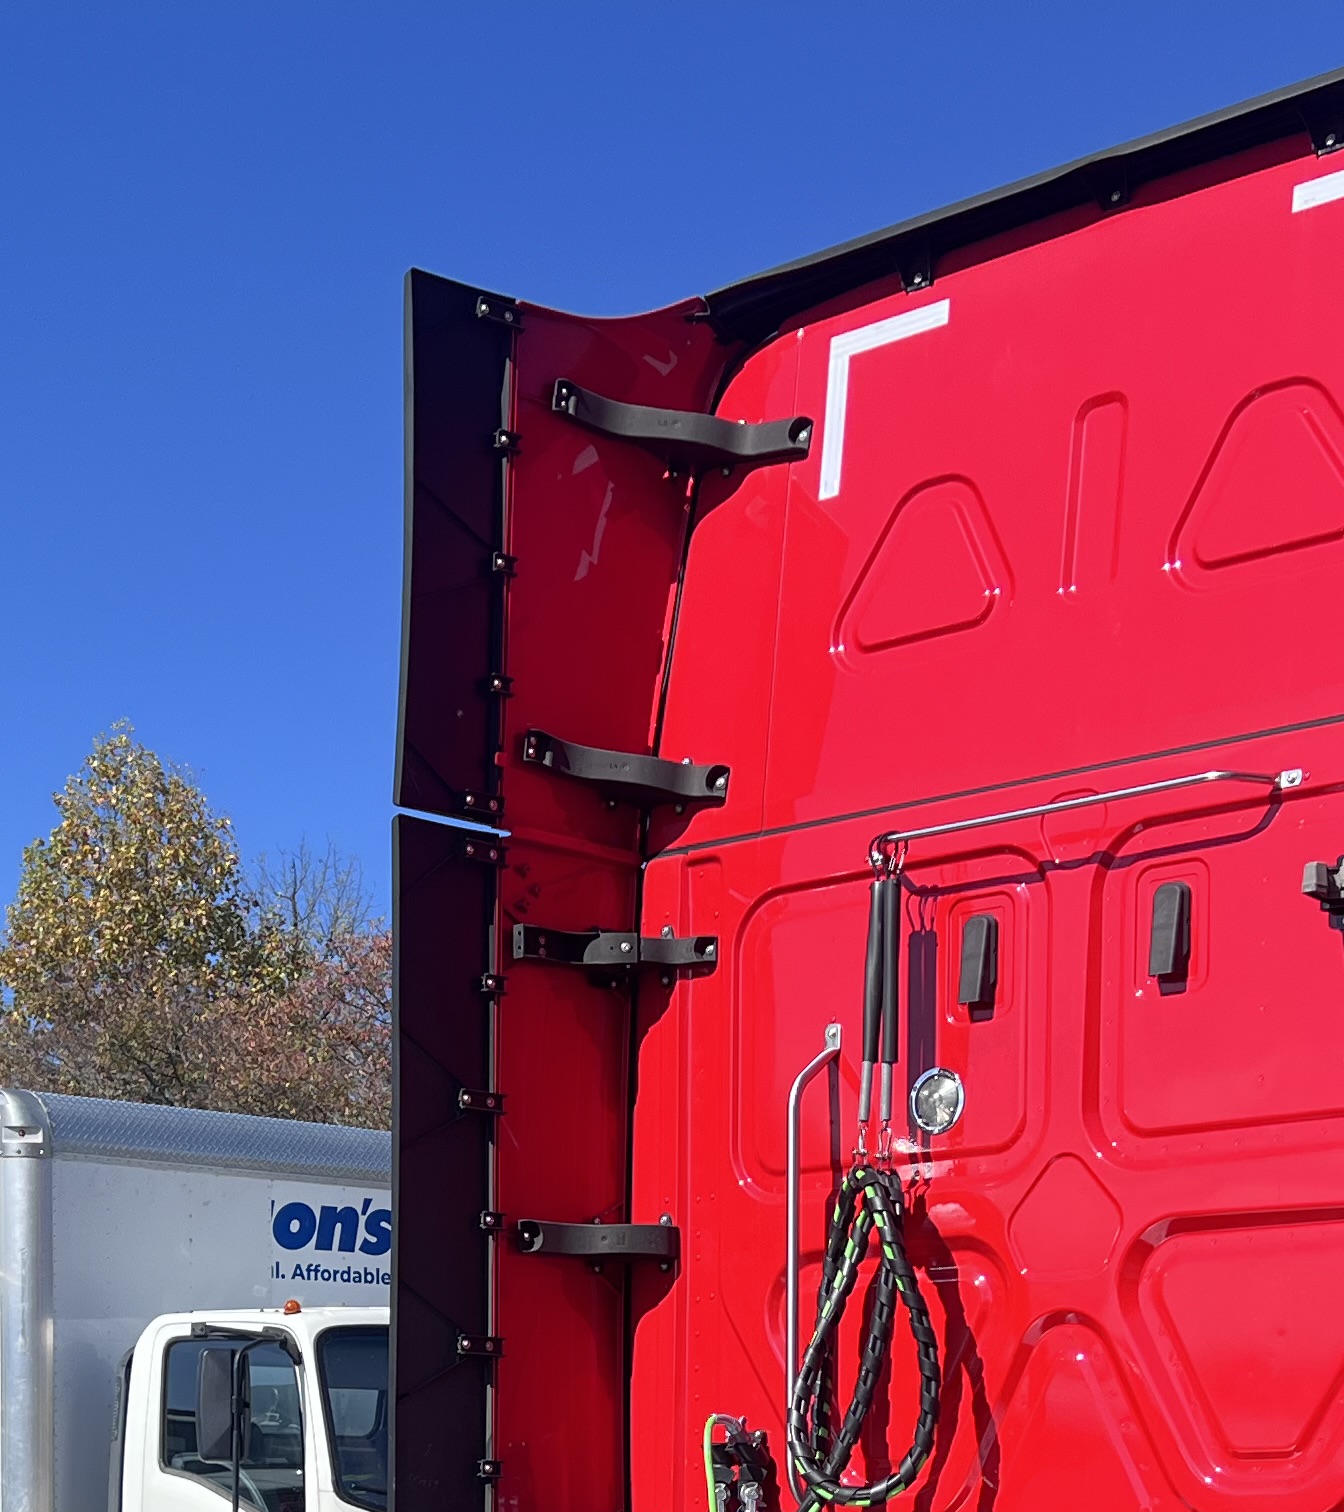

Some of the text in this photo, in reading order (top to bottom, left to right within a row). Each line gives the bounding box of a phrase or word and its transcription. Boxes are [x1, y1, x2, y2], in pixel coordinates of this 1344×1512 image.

[271, 1198, 391, 1256] on's
[271, 1261, 391, 1285] l. Affordable
